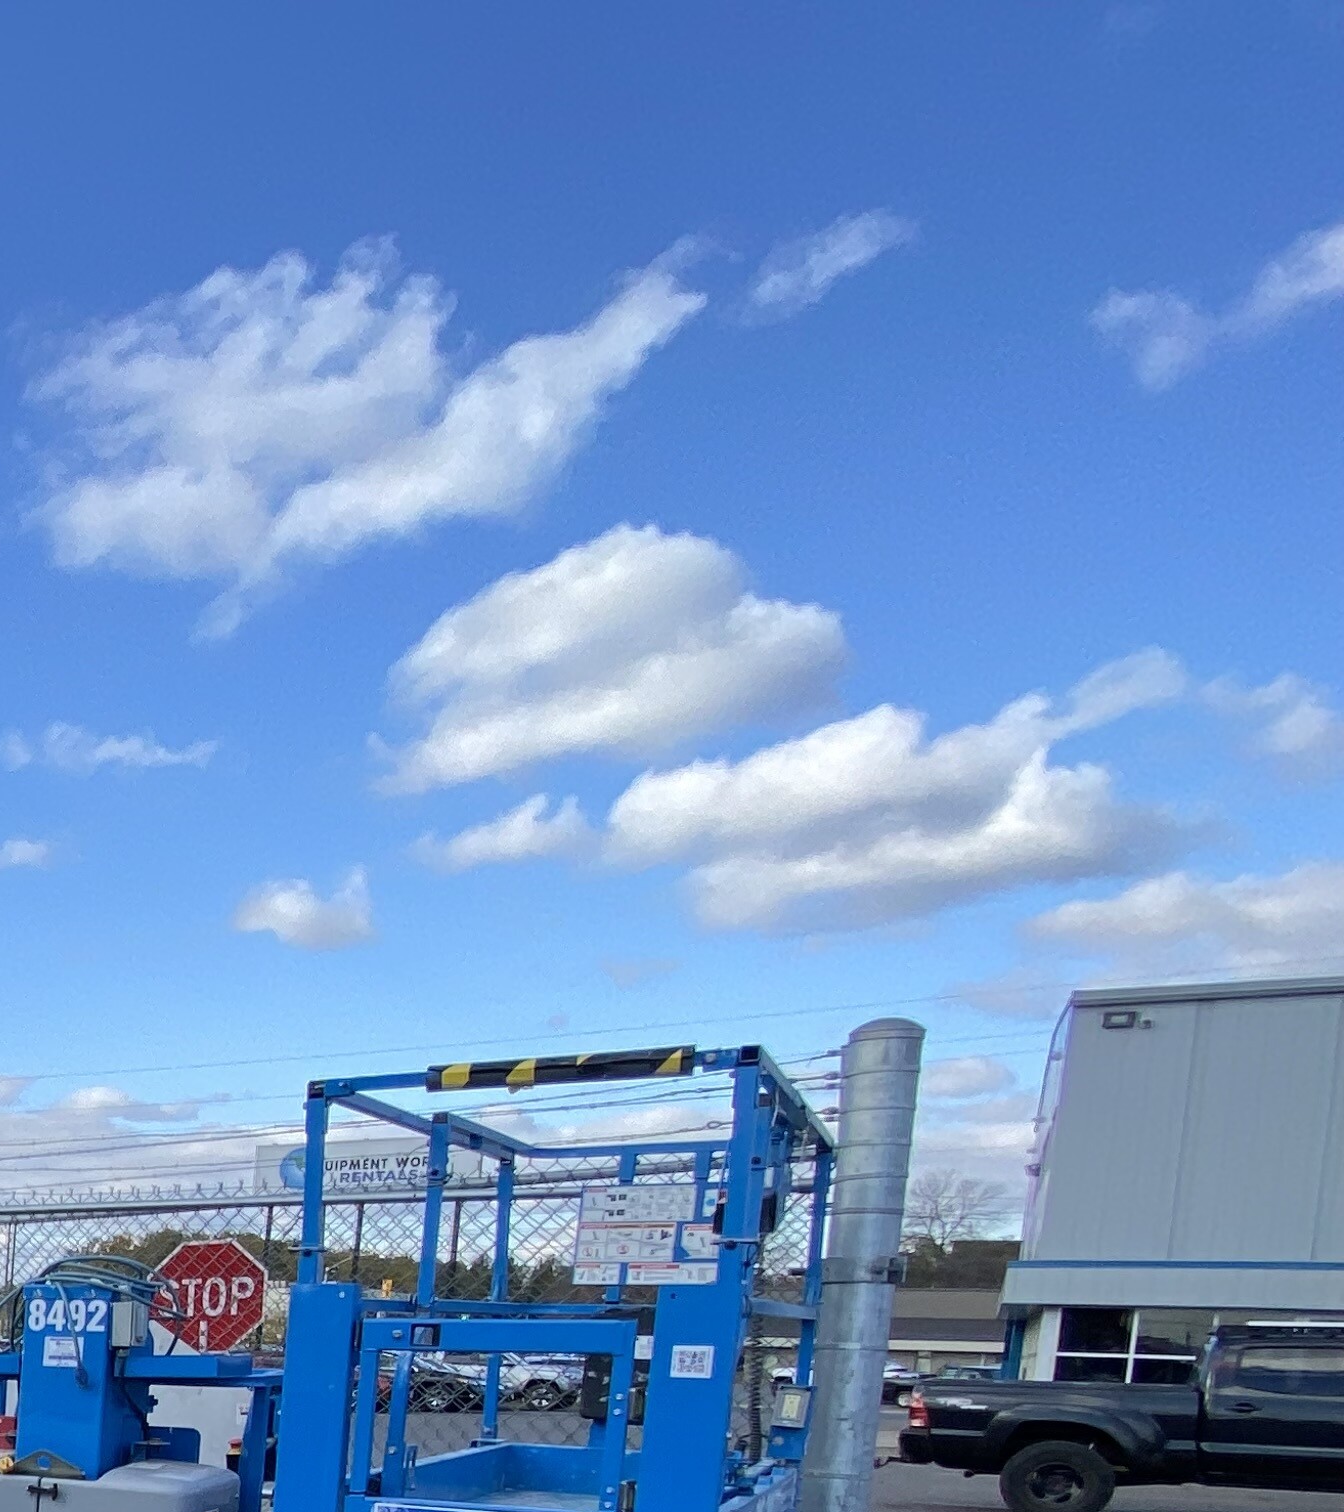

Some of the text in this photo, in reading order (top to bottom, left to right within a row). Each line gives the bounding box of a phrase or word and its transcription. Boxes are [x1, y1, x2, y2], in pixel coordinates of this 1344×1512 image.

[325, 1157, 388, 1172] UIPMENT
[339, 1169, 418, 1184] RENTALS
[158, 1276, 255, 1319] STOP
[28, 1299, 108, 1332] 8492
